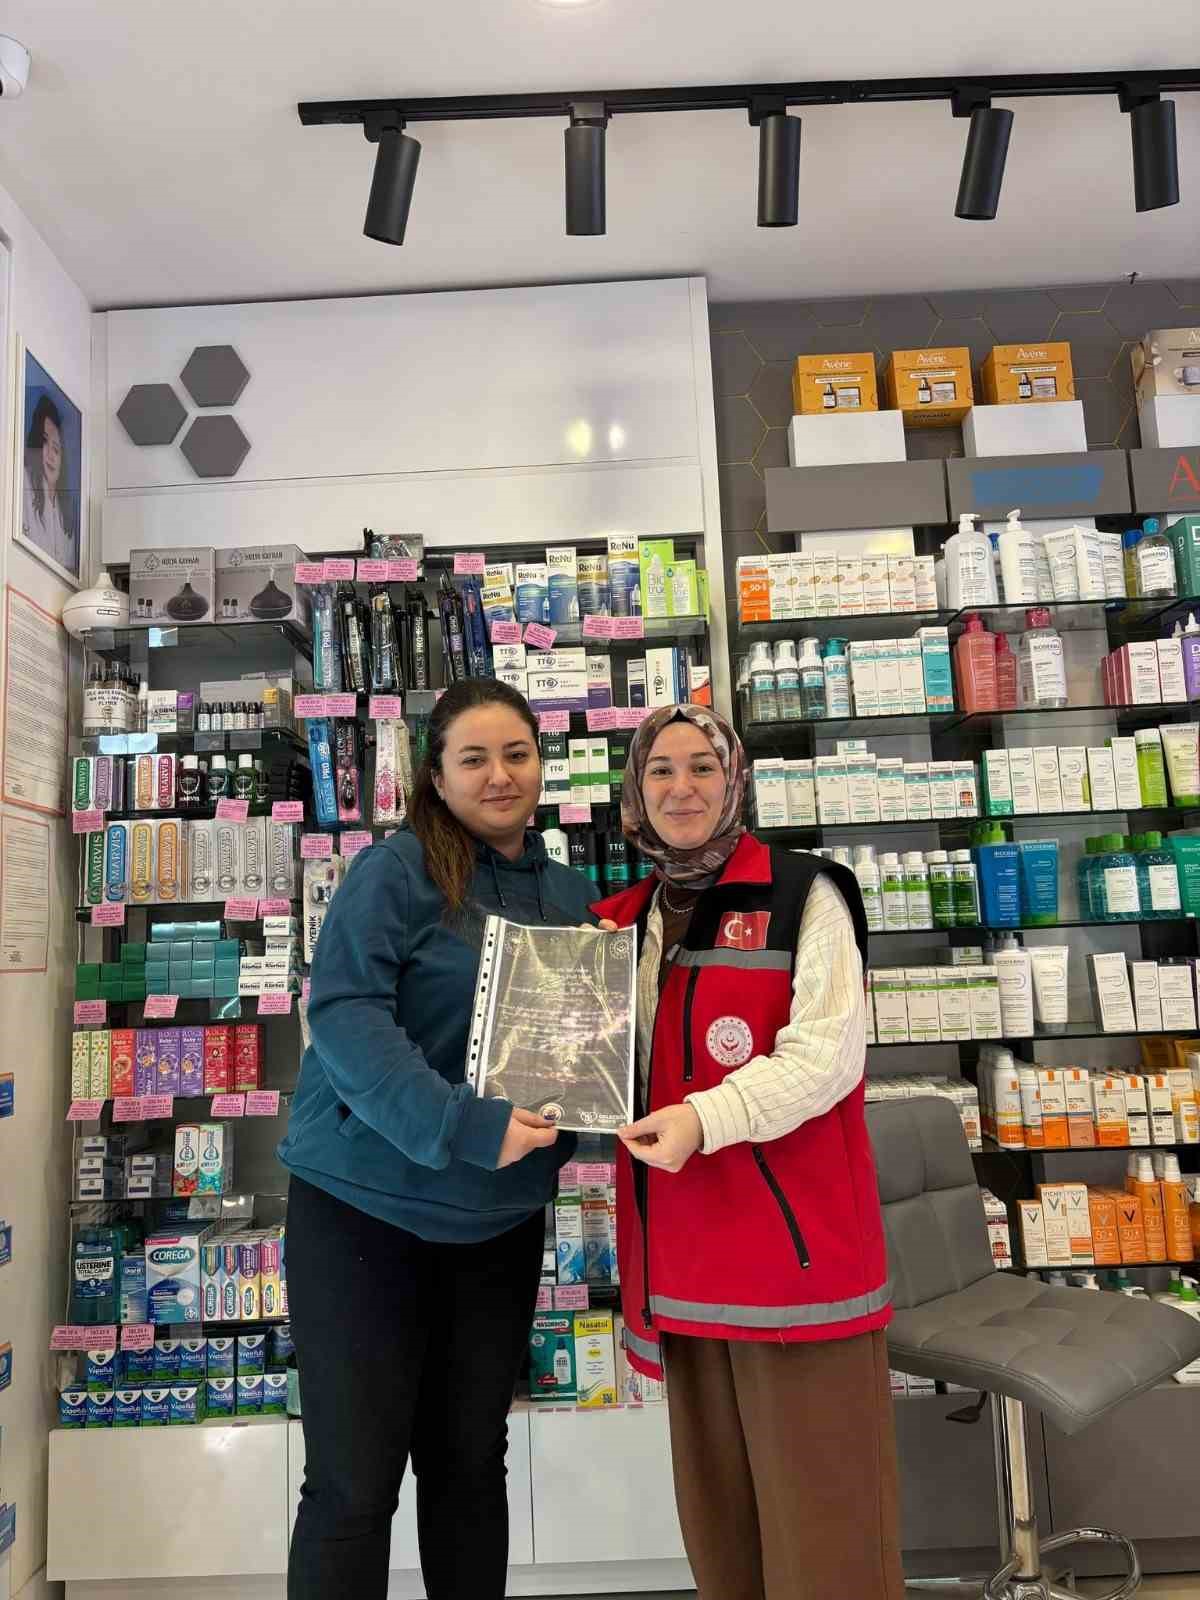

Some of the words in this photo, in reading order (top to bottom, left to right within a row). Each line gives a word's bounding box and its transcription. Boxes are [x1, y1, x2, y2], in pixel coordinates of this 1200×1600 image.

[610, 541, 635, 550] ReNu
[482, 592, 501, 600] ReNu
[77, 760, 89, 798] MARVIS
[160, 757, 170, 797] MARVIS
[92, 834, 104, 888] MARVIS
[110, 830, 122, 884] MARVIS
[76, 1260, 113, 1271] LISTERINE
[152, 1249, 192, 1261] COREGA
